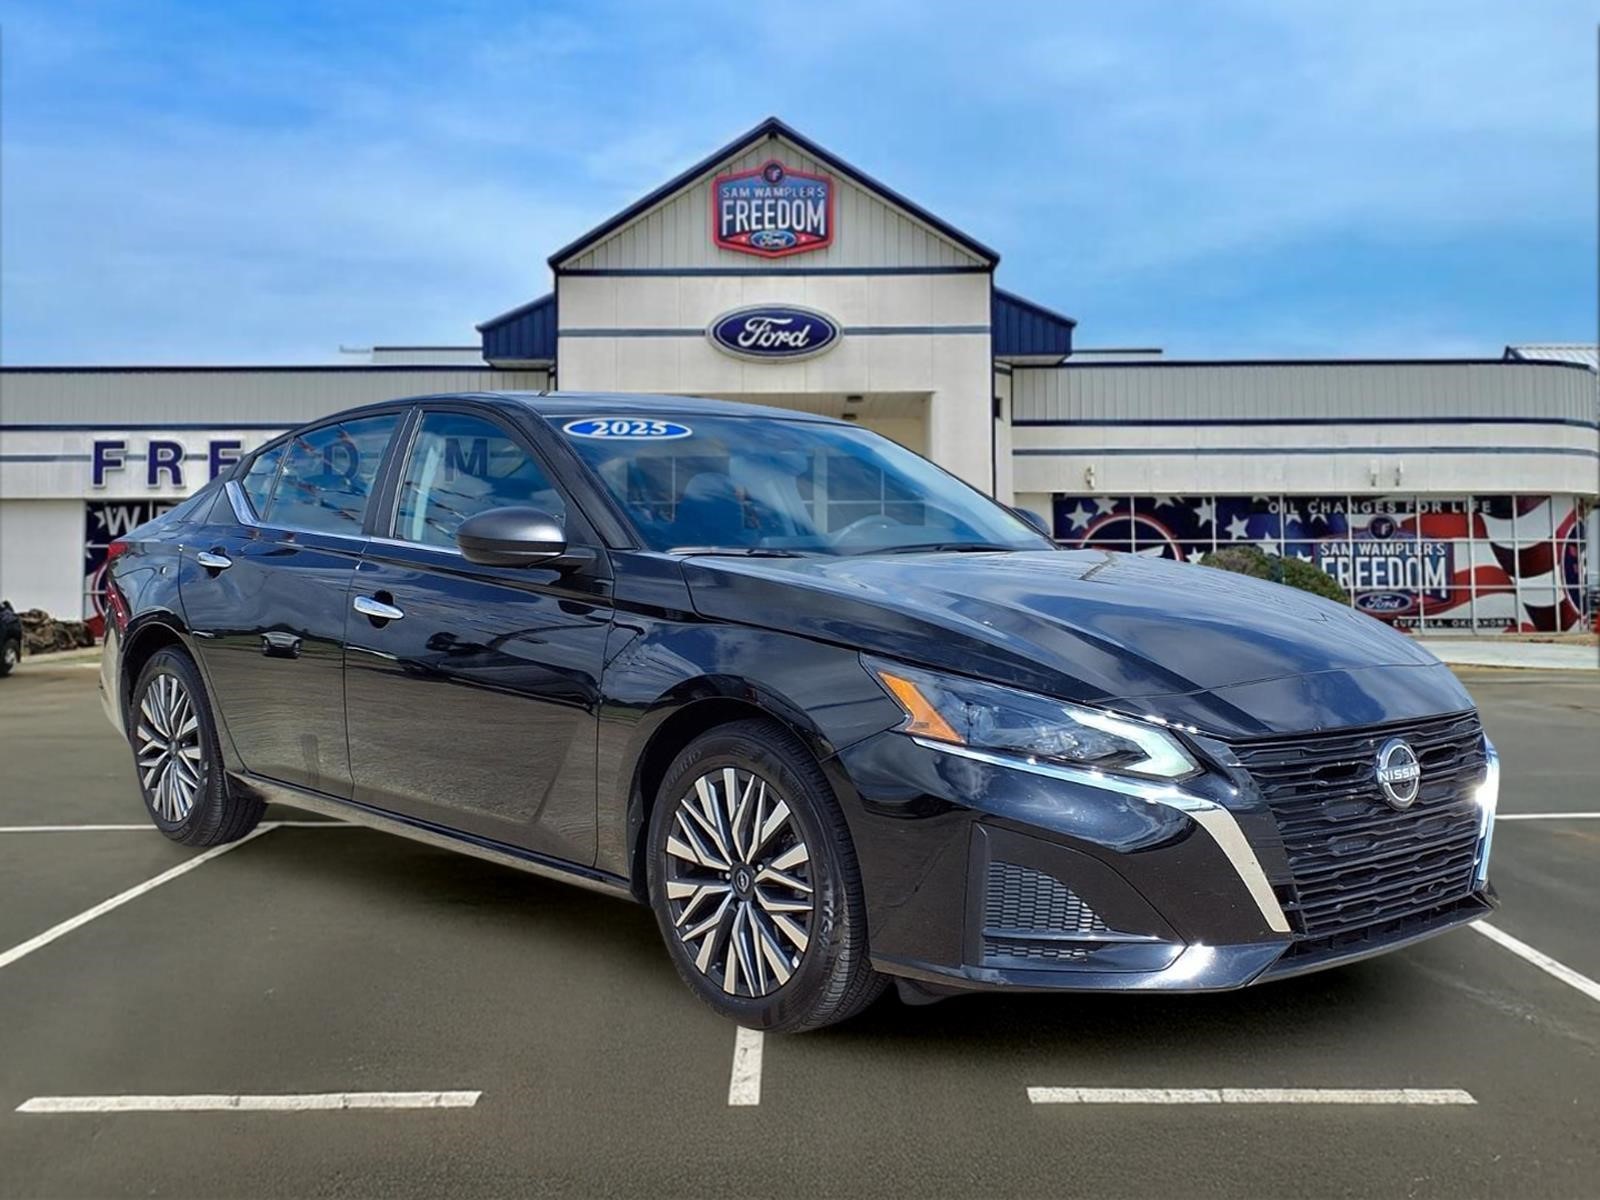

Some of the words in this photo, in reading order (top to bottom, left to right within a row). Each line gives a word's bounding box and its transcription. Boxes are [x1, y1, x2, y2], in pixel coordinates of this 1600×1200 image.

[722, 187, 750, 198] SAM
[721, 199, 826, 236] FREEDOM
[737, 316, 811, 348] Ford
[591, 421, 668, 436] 2025
[1268, 502, 1299, 514] OIL
[1308, 502, 1397, 514] CHANGES
[1405, 501, 1443, 514] FOR
[1451, 501, 1492, 514] LIFE
[1321, 556, 1448, 598] FREEDOM
[1366, 595, 1399, 609] Ford
[1379, 765, 1420, 783] NISSAN
